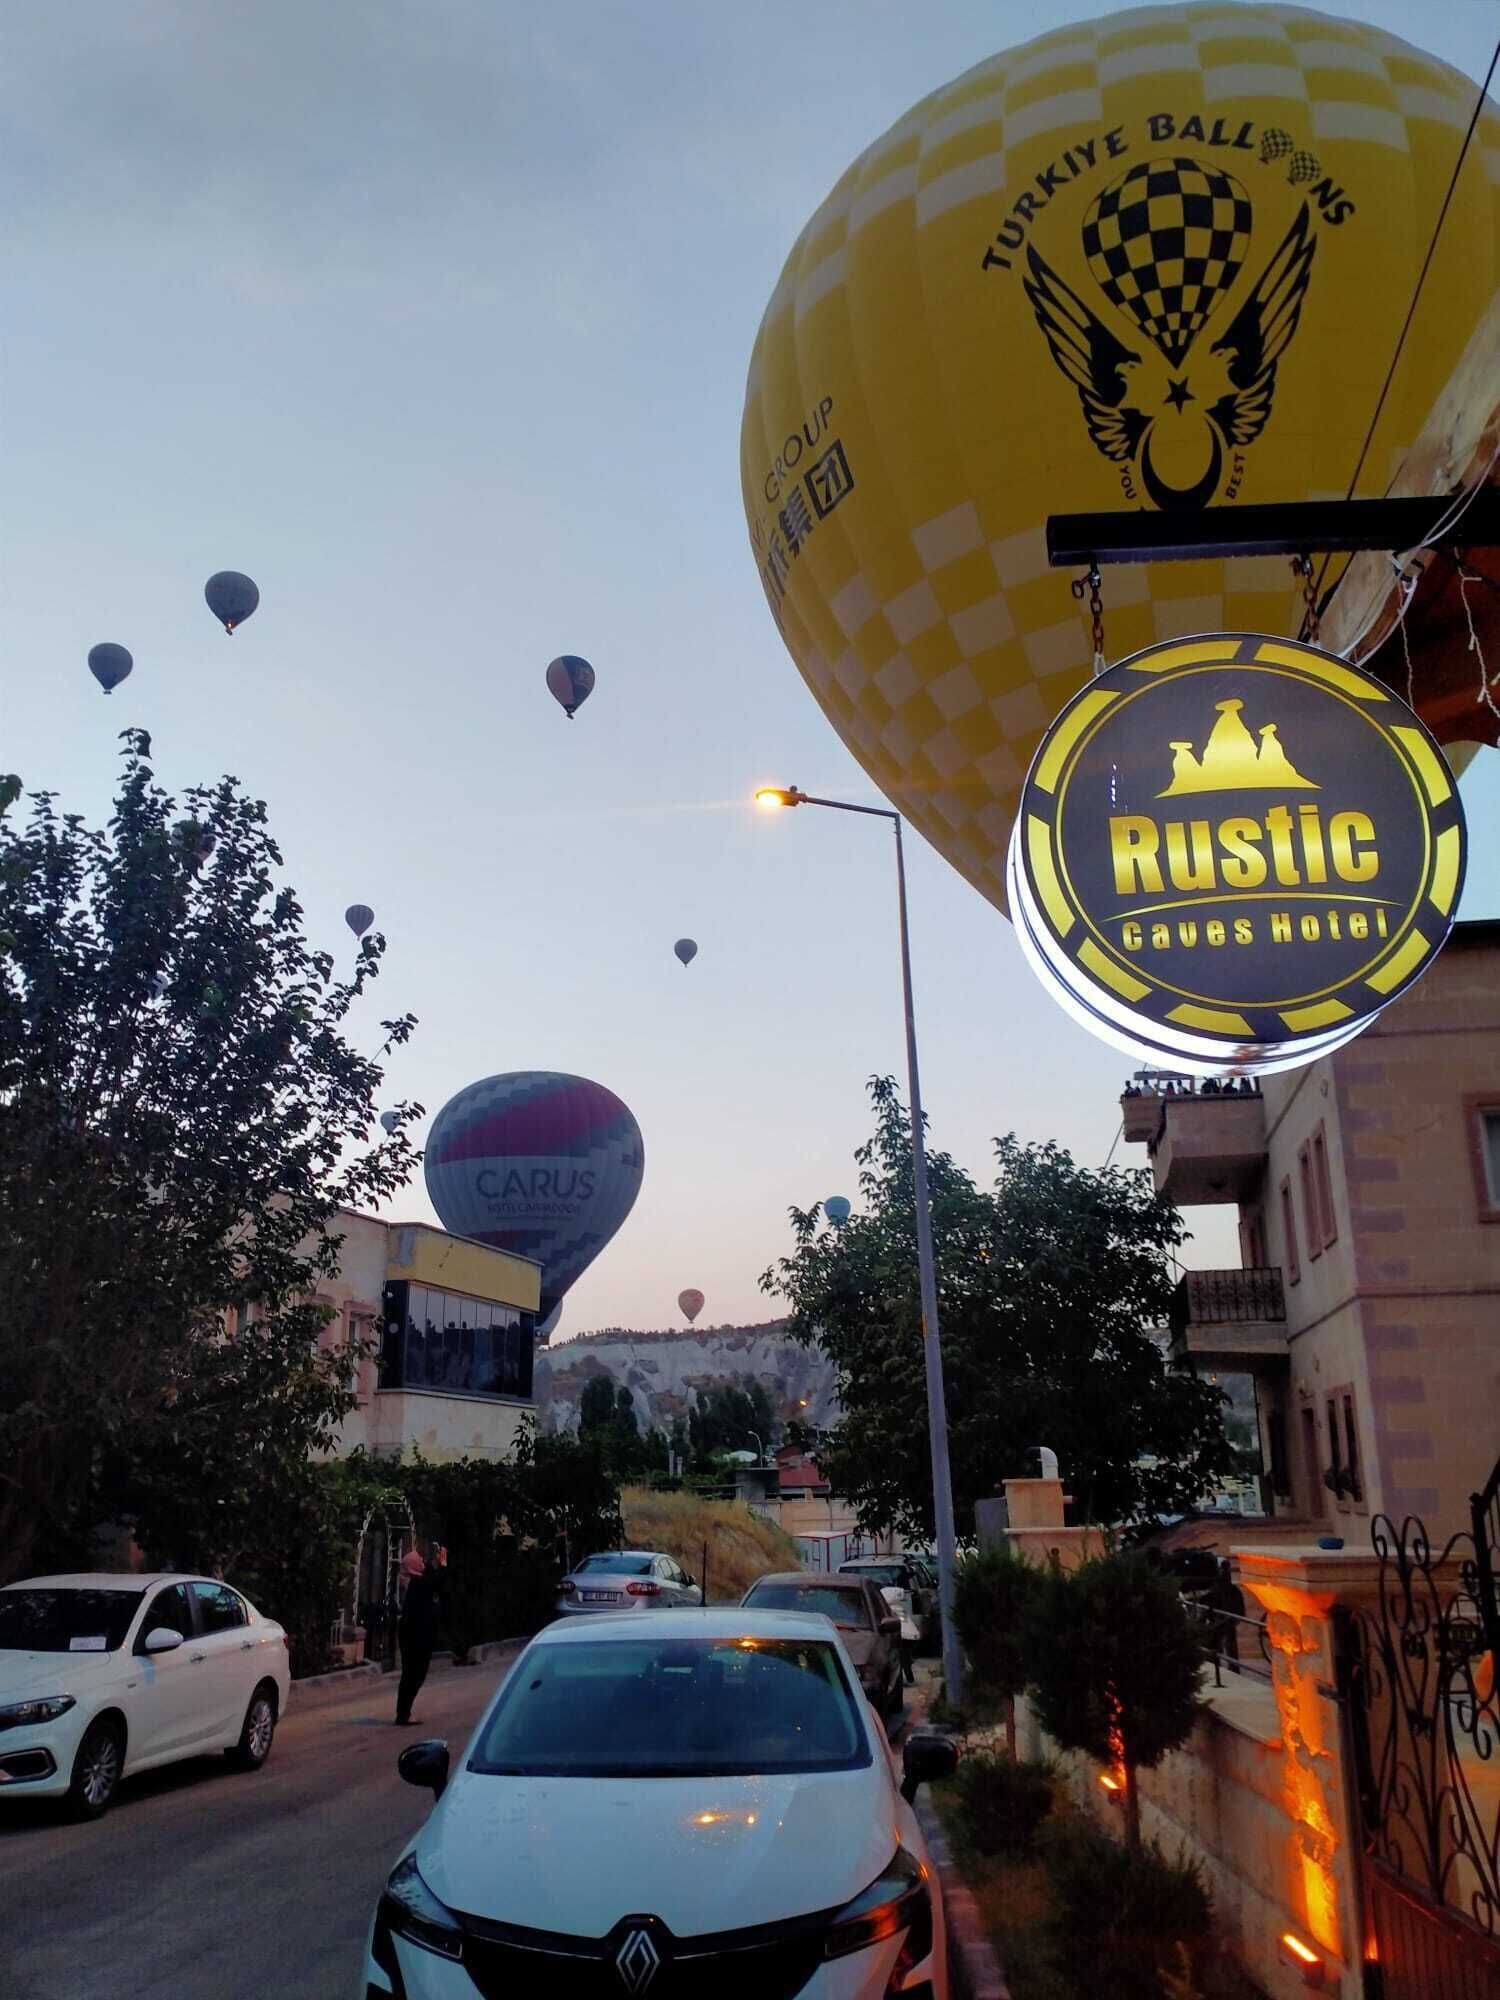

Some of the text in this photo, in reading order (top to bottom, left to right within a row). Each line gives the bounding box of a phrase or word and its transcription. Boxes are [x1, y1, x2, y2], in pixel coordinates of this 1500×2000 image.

[764, 395, 833, 503] GROUP
[1119, 453, 1245, 500] YOU BEST
[1109, 804, 1380, 895] Rustic
[1122, 907, 1389, 951] Caves Hotel
[475, 1168, 596, 1200] CARUS
